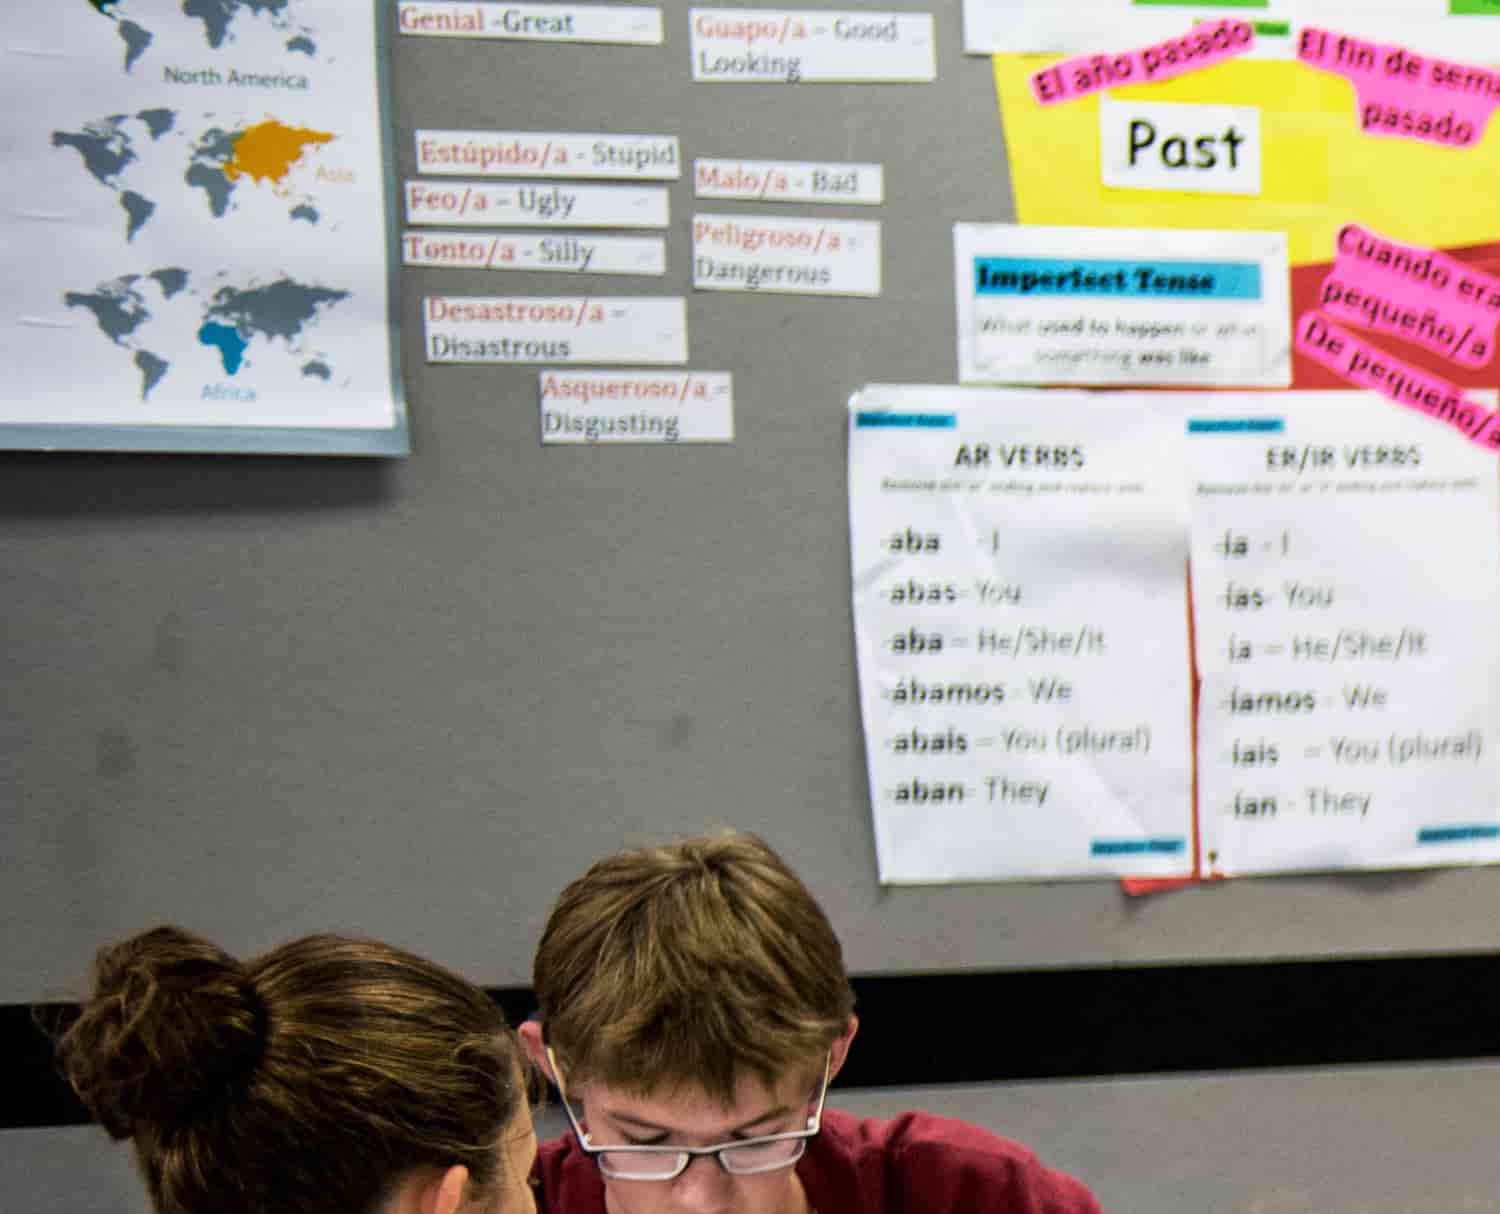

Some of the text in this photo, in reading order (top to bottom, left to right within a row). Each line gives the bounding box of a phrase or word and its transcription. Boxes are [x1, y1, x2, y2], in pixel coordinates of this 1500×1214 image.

[400, 7, 484, 31] Genial
[695, 16, 898, 44] Guapo/a Good
[698, 51, 801, 80] Looking
[1034, 20, 1252, 101] El año pasado
[1300, 29, 1327, 57] El
[1336, 40, 1373, 71] fin
[1385, 47, 1421, 78] de
[164, 66, 308, 91] North America
[1362, 104, 1473, 143] pasado
[592, 142, 675, 170] Stupid
[1128, 121, 1243, 169] Past
[315, 164, 355, 185] Asia
[695, 166, 857, 194] Malo/a Bad
[409, 184, 576, 219] Feo/a Ugly
[694, 220, 841, 252] Peligroso/a
[406, 236, 595, 270] Tonto/a Silly
[1336, 225, 1448, 292] Cuando
[695, 258, 830, 289] Dangerous
[978, 265, 1214, 293] Imperfect Tense
[427, 297, 605, 326] Desastroso/a
[1322, 280, 1489, 360] pequeño/a
[429, 332, 570, 359] Disastrous
[1303, 320, 1347, 355] De
[201, 383, 256, 404] Africa
[541, 375, 707, 402] Asqueroso/a
[542, 410, 680, 439] Disgusting
[954, 442, 1086, 467] AR VERBS
[1266, 445, 1421, 475] ER/IR VERBS
[976, 579, 1021, 604] You
[1284, 580, 1334, 607] You
[977, 625, 1106, 658] He/She/It
[1292, 630, 1426, 662] He/She/It
[1029, 677, 1072, 701] We
[1343, 686, 1388, 709] We
[1002, 727, 1046, 751] You
[1056, 726, 1151, 754] (plural)
[1330, 731, 1483, 762] You (plural)
[984, 775, 1049, 806] They
[1306, 787, 1370, 816] They
